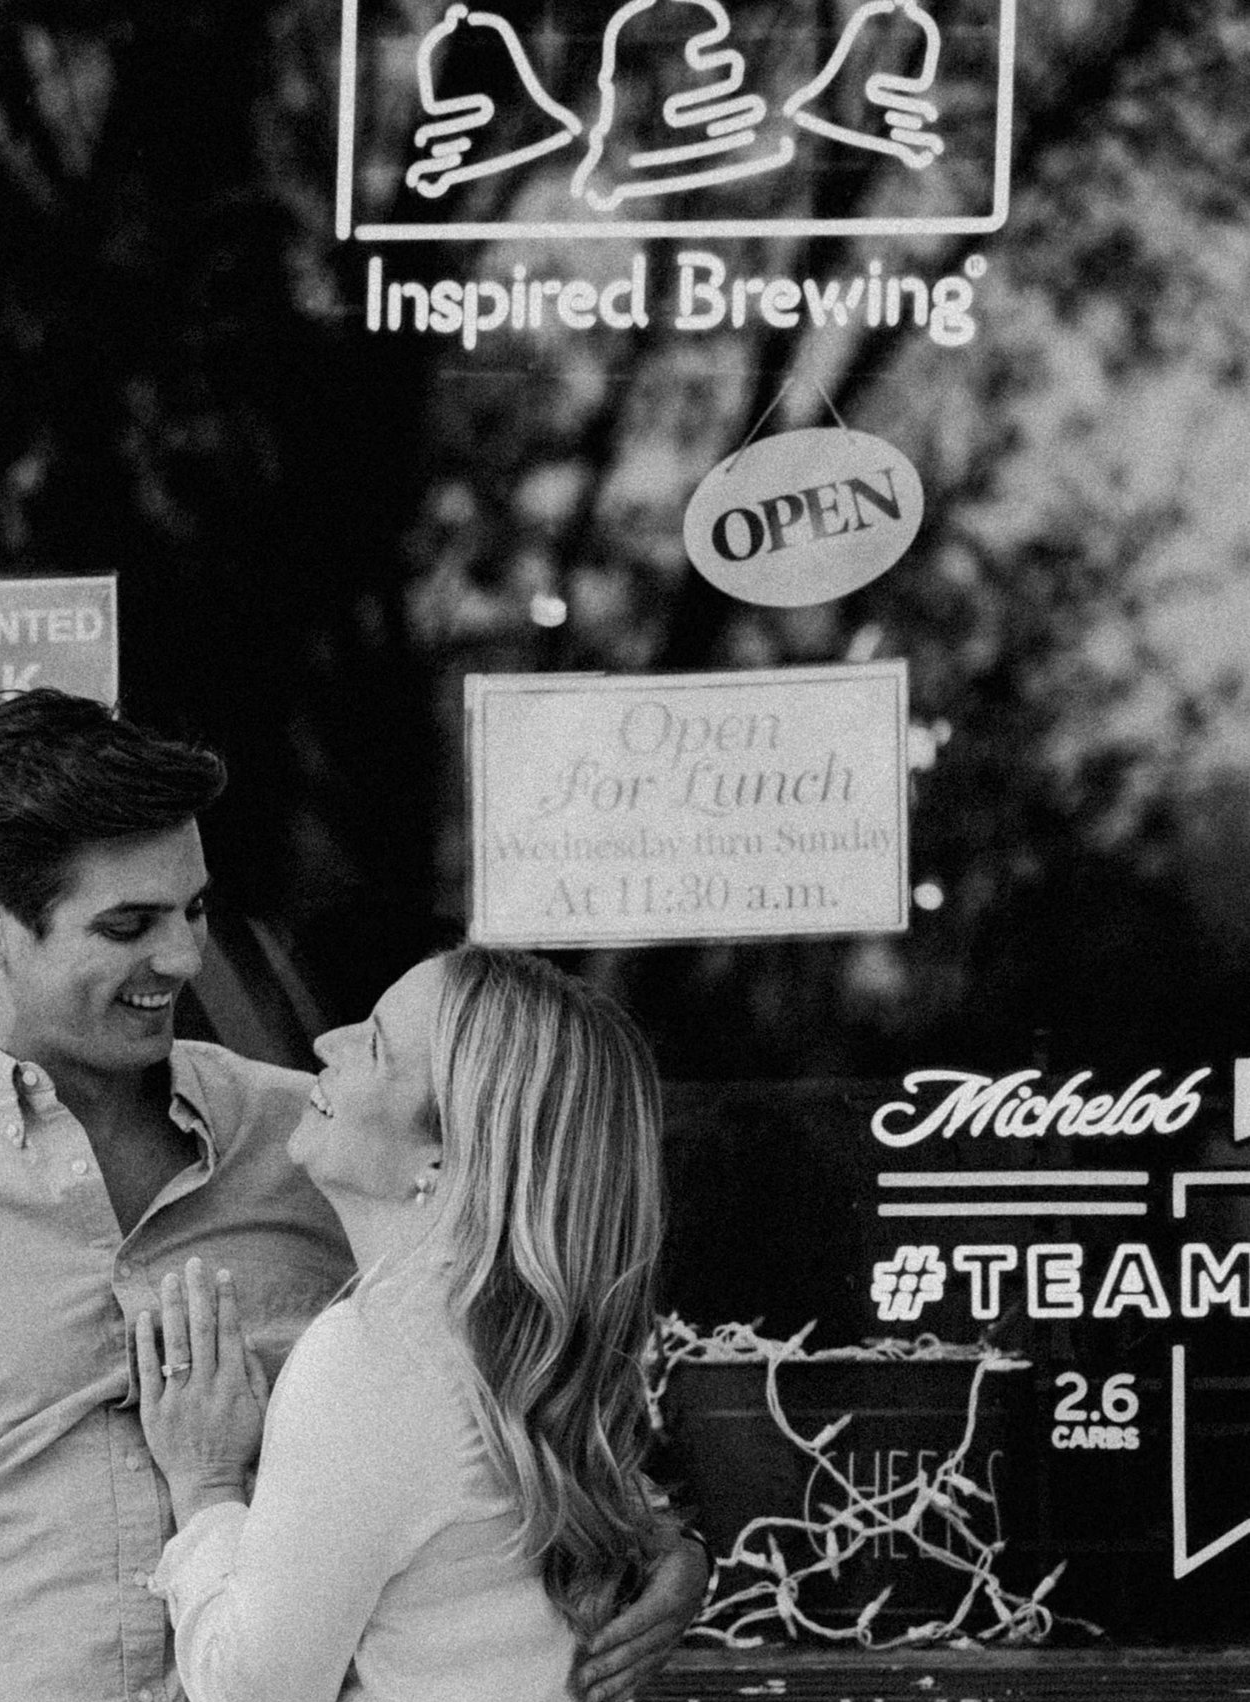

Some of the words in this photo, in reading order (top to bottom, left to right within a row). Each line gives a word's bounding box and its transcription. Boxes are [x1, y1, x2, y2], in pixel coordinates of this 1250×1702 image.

[366, 254, 649, 350] Inspired
[710, 467, 903, 563] OPEN
[618, 699, 781, 770] Open
[672, 749, 855, 819] Lunch
[494, 827, 683, 863] Wednesday
[775, 818, 893, 856] Sunday
[545, 876, 598, 918] At
[618, 872, 730, 916] 11:30
[746, 880, 839, 912] a.m.
[870, 1066, 1212, 1148] Michelob
[870, 1242, 1250, 1321] #TEAM
[1053, 1371, 1140, 1423] 2.6
[1051, 1424, 1140, 1450] CARBS
